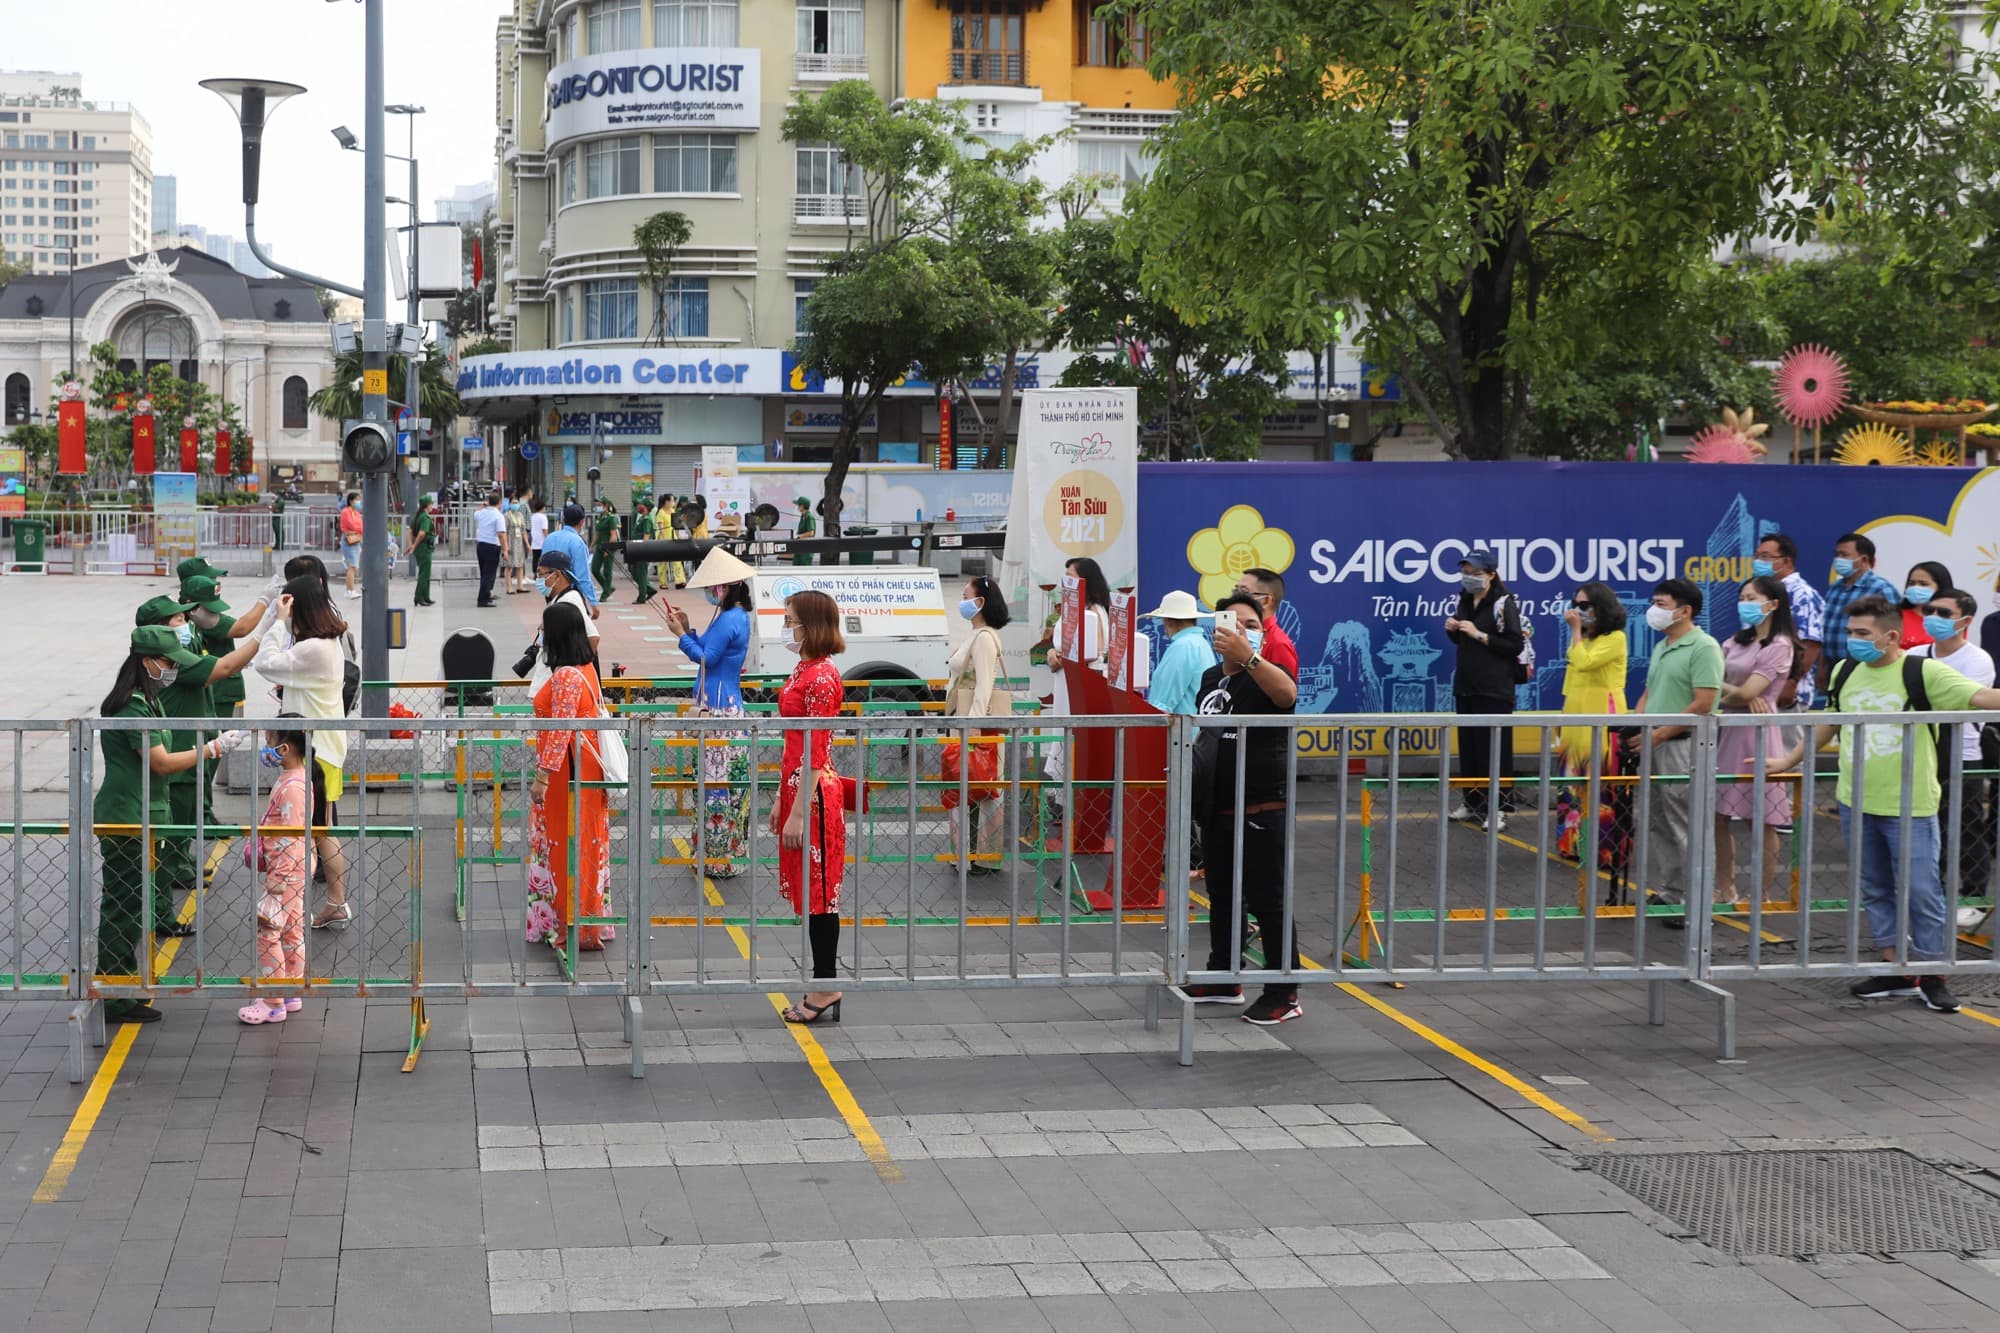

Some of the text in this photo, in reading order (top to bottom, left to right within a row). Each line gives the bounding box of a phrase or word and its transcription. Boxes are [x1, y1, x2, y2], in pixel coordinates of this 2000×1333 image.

[480, 358, 621, 388] Information
[632, 358, 749, 385] Center
[370, 379, 381, 387] 73
[1106, 411, 1124, 421] MINH
[1061, 517, 1105, 542] 2021
[836, 580, 846, 589] TY
[884, 594, 915, 604] TP.HCM
[1371, 595, 1410, 622] Tận
